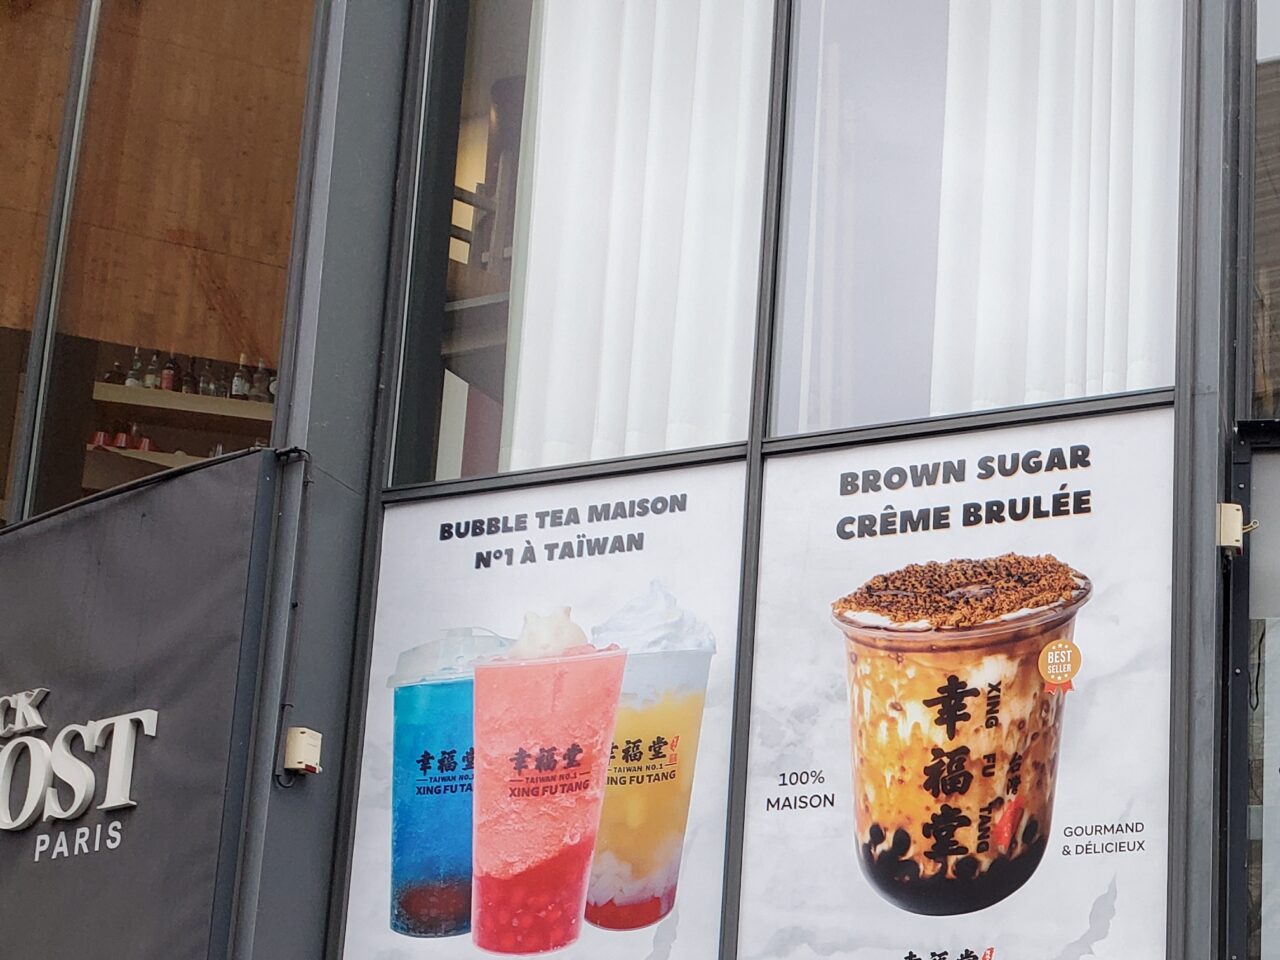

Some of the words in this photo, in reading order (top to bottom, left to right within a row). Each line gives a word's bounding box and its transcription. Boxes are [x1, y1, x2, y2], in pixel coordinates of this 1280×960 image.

[839, 459, 966, 496] BROWN
[976, 444, 1091, 480] SUGAR
[439, 513, 528, 541] BUBBLE
[535, 507, 581, 529] TEA
[587, 493, 688, 523] MAISON
[836, 504, 951, 541] CRÊME
[962, 483, 1092, 527] BRULÉE
[520, 540, 537, 564] À
[544, 532, 645, 561] TAÏWAN
[1047, 650, 1072, 664] BEST
[1047, 663, 1072, 674] SELLER
[985, 681, 1002, 730] XING
[509, 743, 584, 776] 幸福堂
[613, 764, 642, 773] TAIWAN
[645, 762, 664, 772] NO.1
[922, 674, 981, 861] 幸福堂
[981, 752, 997, 778] FU
[429, 775, 458, 784] TAIWAN
[525, 774, 557, 785] TAIWAN
[559, 772, 578, 782] NO.1
[606, 773, 627, 786] ING
[628, 773, 644, 785] FU
[647, 769, 676, 784] TANG
[778, 770, 825, 787] 100%
[416, 785, 442, 796] XING
[443, 784, 458, 794] FU
[458, 783, 474, 793] TA
[508, 786, 540, 798] XING
[541, 784, 559, 797] FU
[559, 779, 589, 795] TANG
[766, 793, 835, 811] MAISON
[976, 804, 993, 854] TANG
[1063, 822, 1145, 838] GOURMAND
[34, 820, 122, 862] PARIS
[1062, 844, 1072, 856] &
[1075, 840, 1146, 855] DÉLICIEUX
